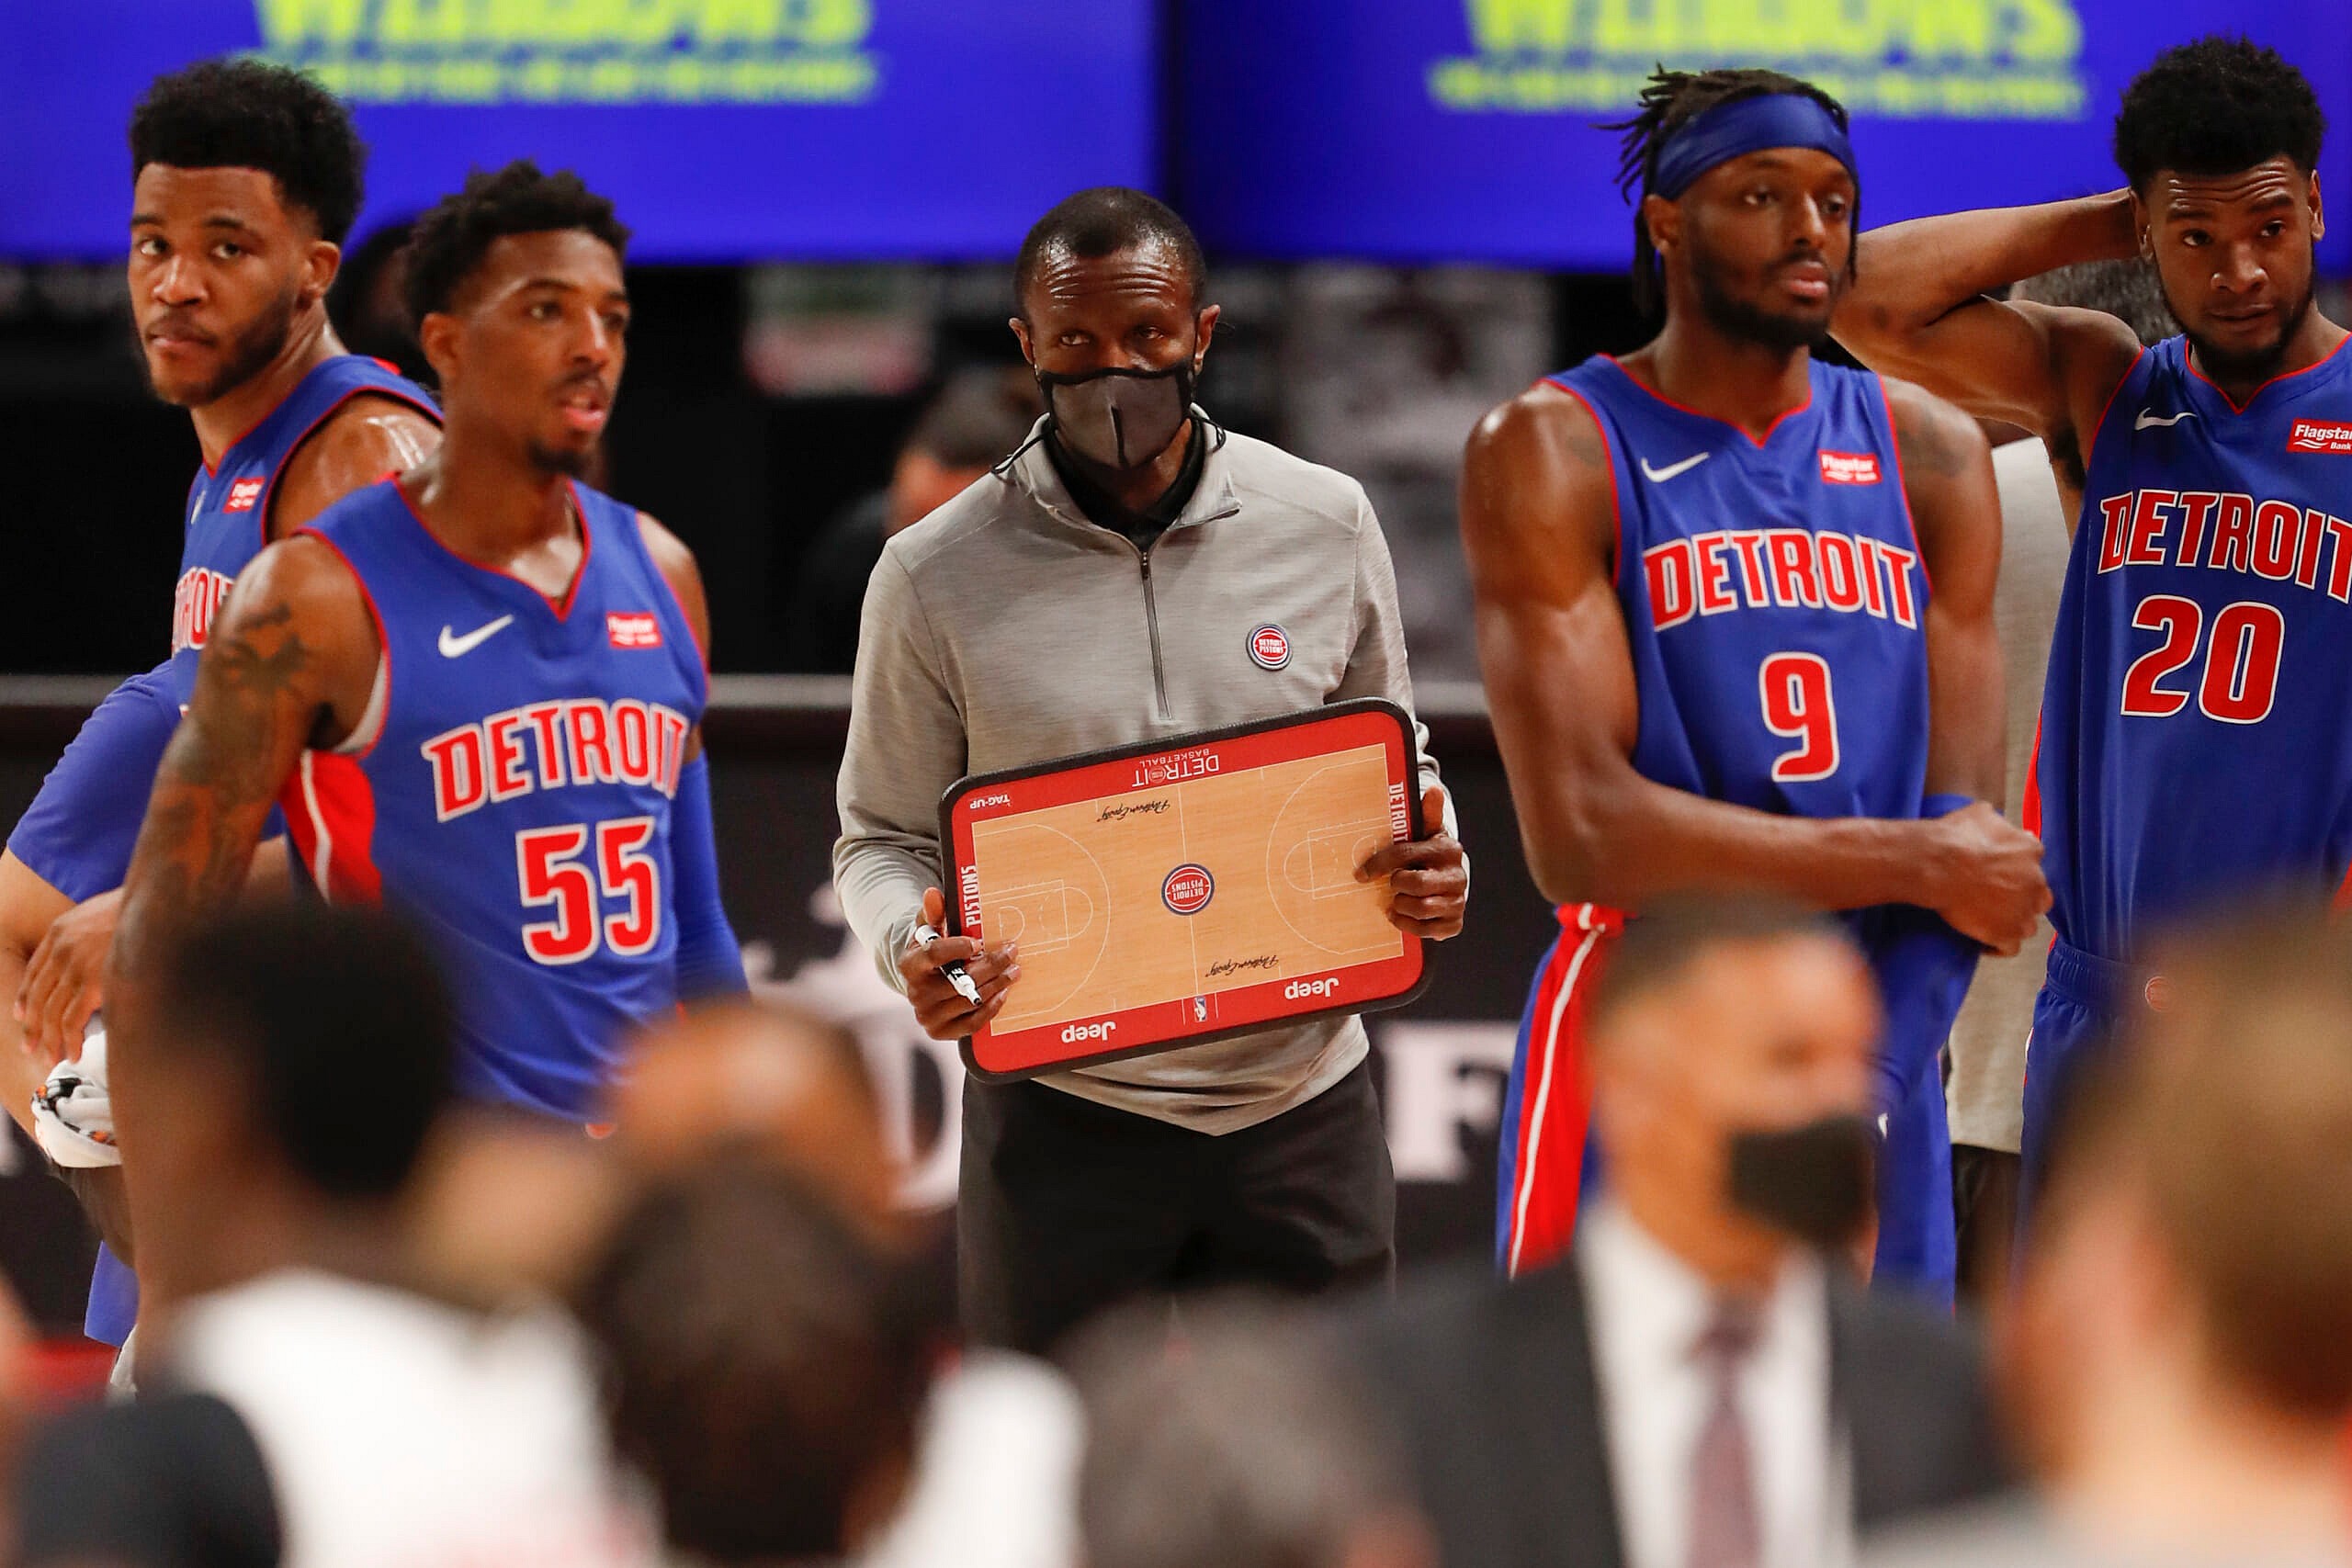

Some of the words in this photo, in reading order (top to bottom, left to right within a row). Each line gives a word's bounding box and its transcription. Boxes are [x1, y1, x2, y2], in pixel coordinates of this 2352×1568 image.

[2098, 489, 2352, 604] DETROIT
[1642, 528, 1917, 632] DETROIT
[2120, 594, 2285, 725] 20
[1758, 651, 1841, 784] 9
[421, 697, 687, 823] DETROIT
[1139, 749, 1210, 768] BASKETBALL
[1388, 780, 1408, 841] DETROIT
[515, 815, 662, 965] 55
[961, 864, 983, 929] PISTONS
[1170, 878, 1204, 893] PISTONS
[1172, 887, 1204, 901] DETROIT
[1284, 977, 1340, 999] Jeep
[1061, 1021, 1116, 1043] Jeep
